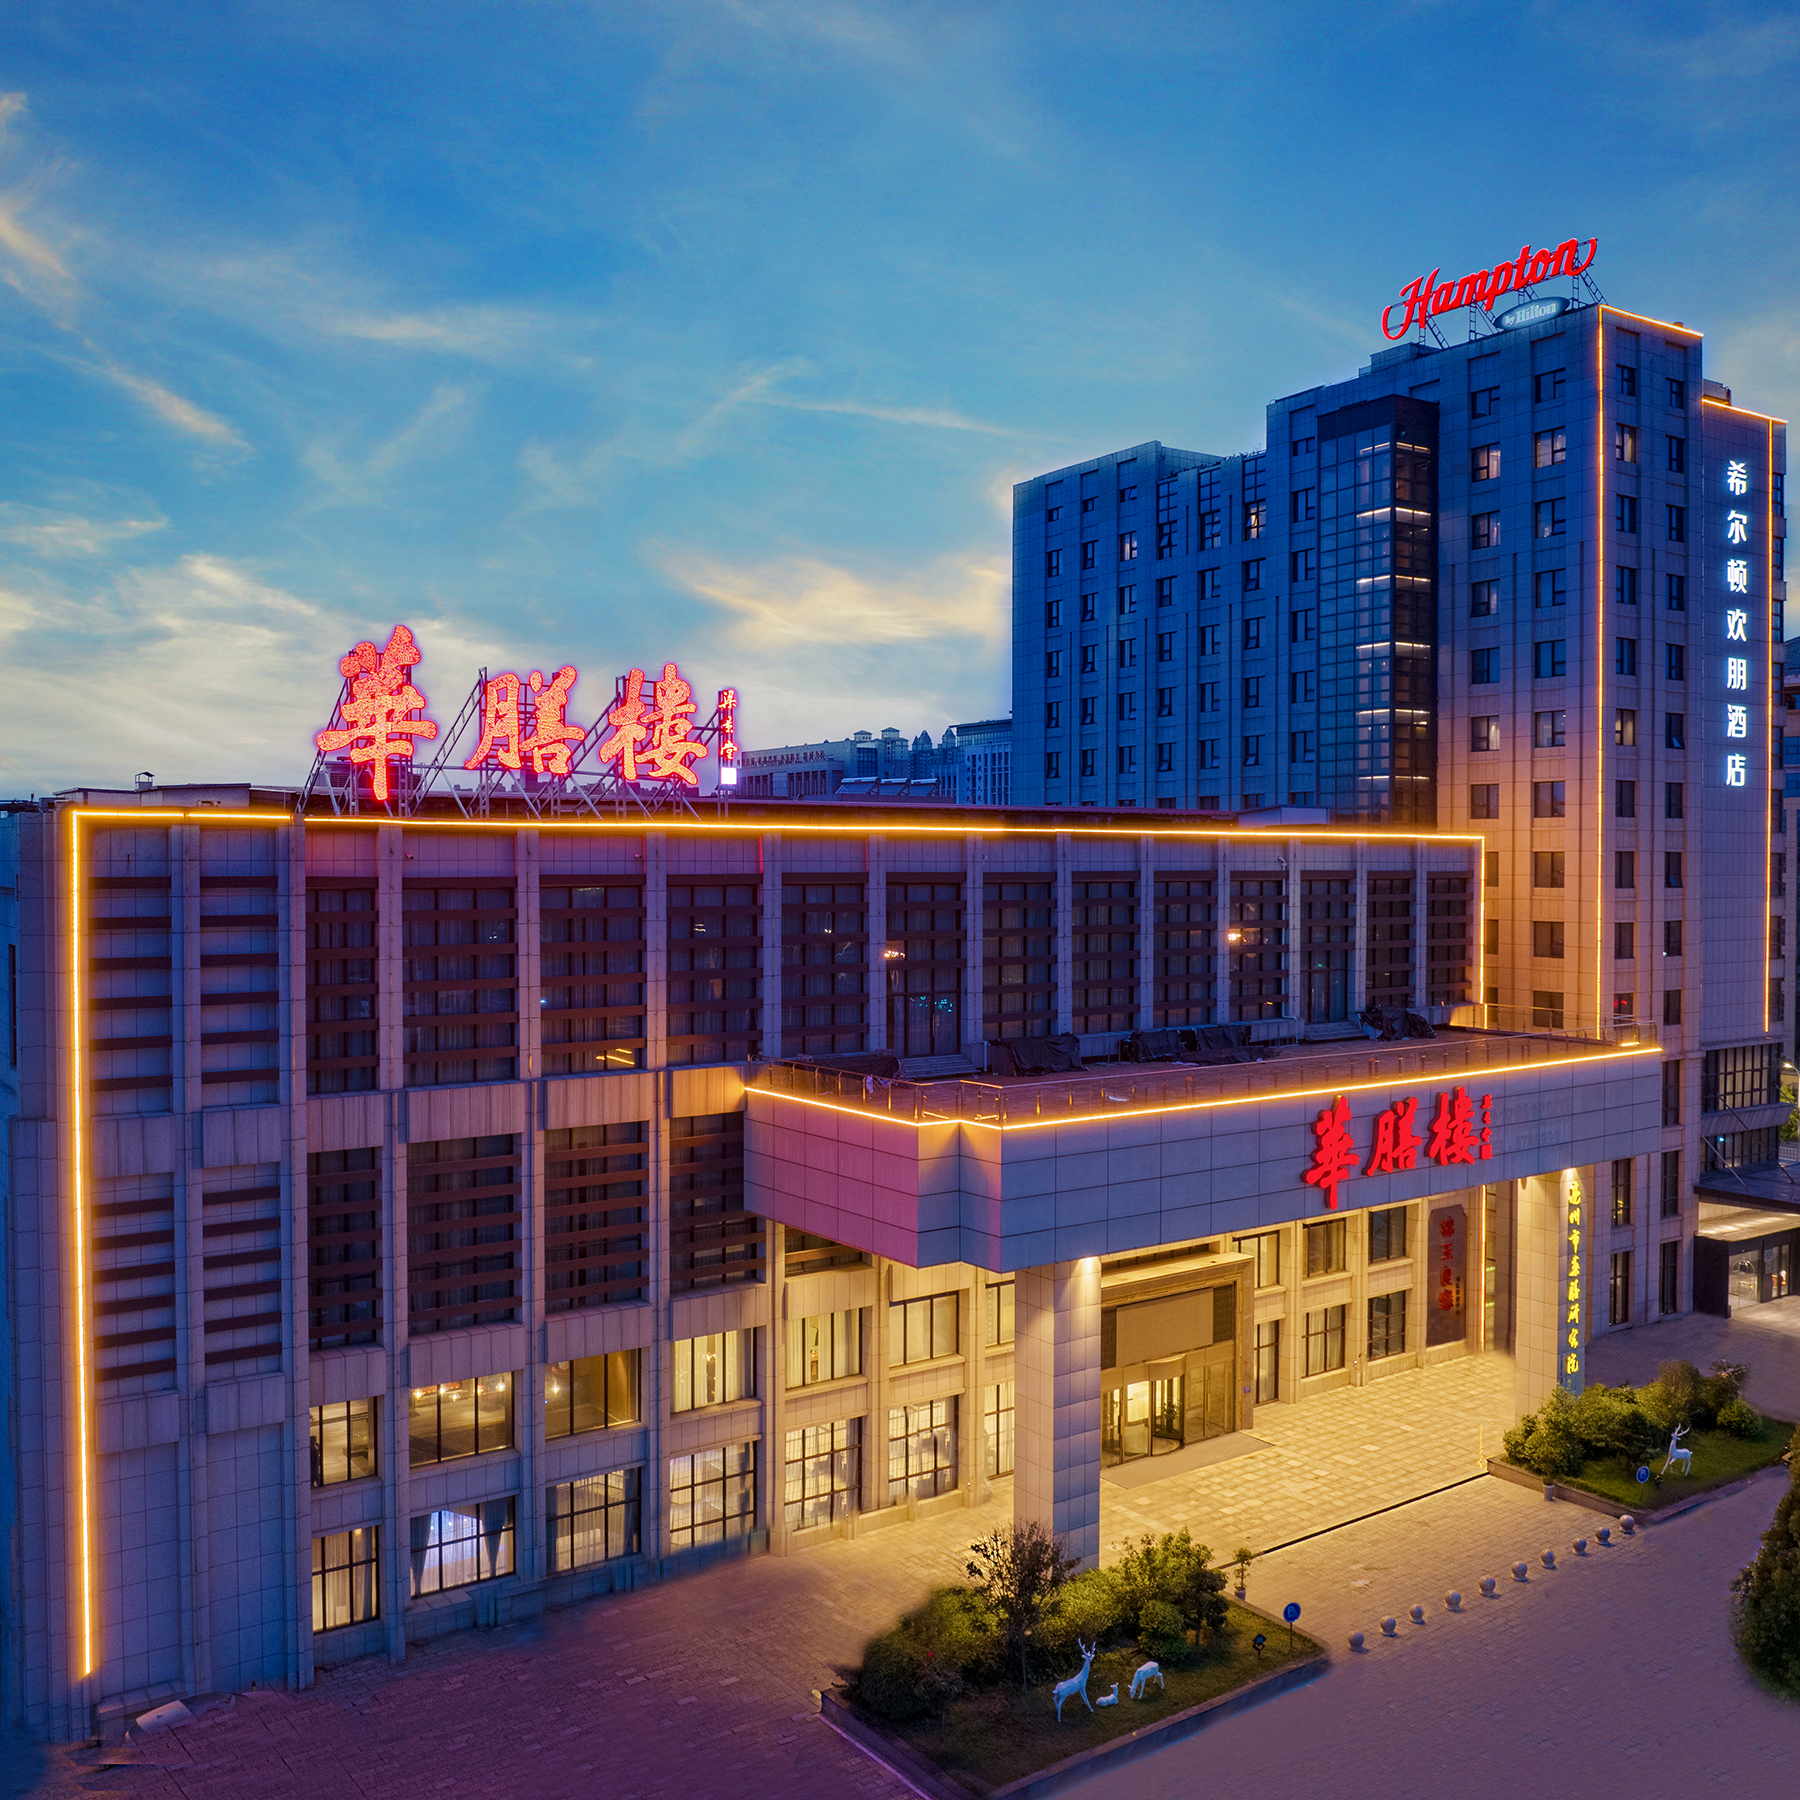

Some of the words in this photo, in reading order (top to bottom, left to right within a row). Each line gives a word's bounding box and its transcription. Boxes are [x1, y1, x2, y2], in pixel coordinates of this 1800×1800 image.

[1381, 237, 1598, 341] Hampton
[1516, 303, 1557, 324] Hilton
[1726, 460, 1748, 786] 希尔顿欢朋酒店
